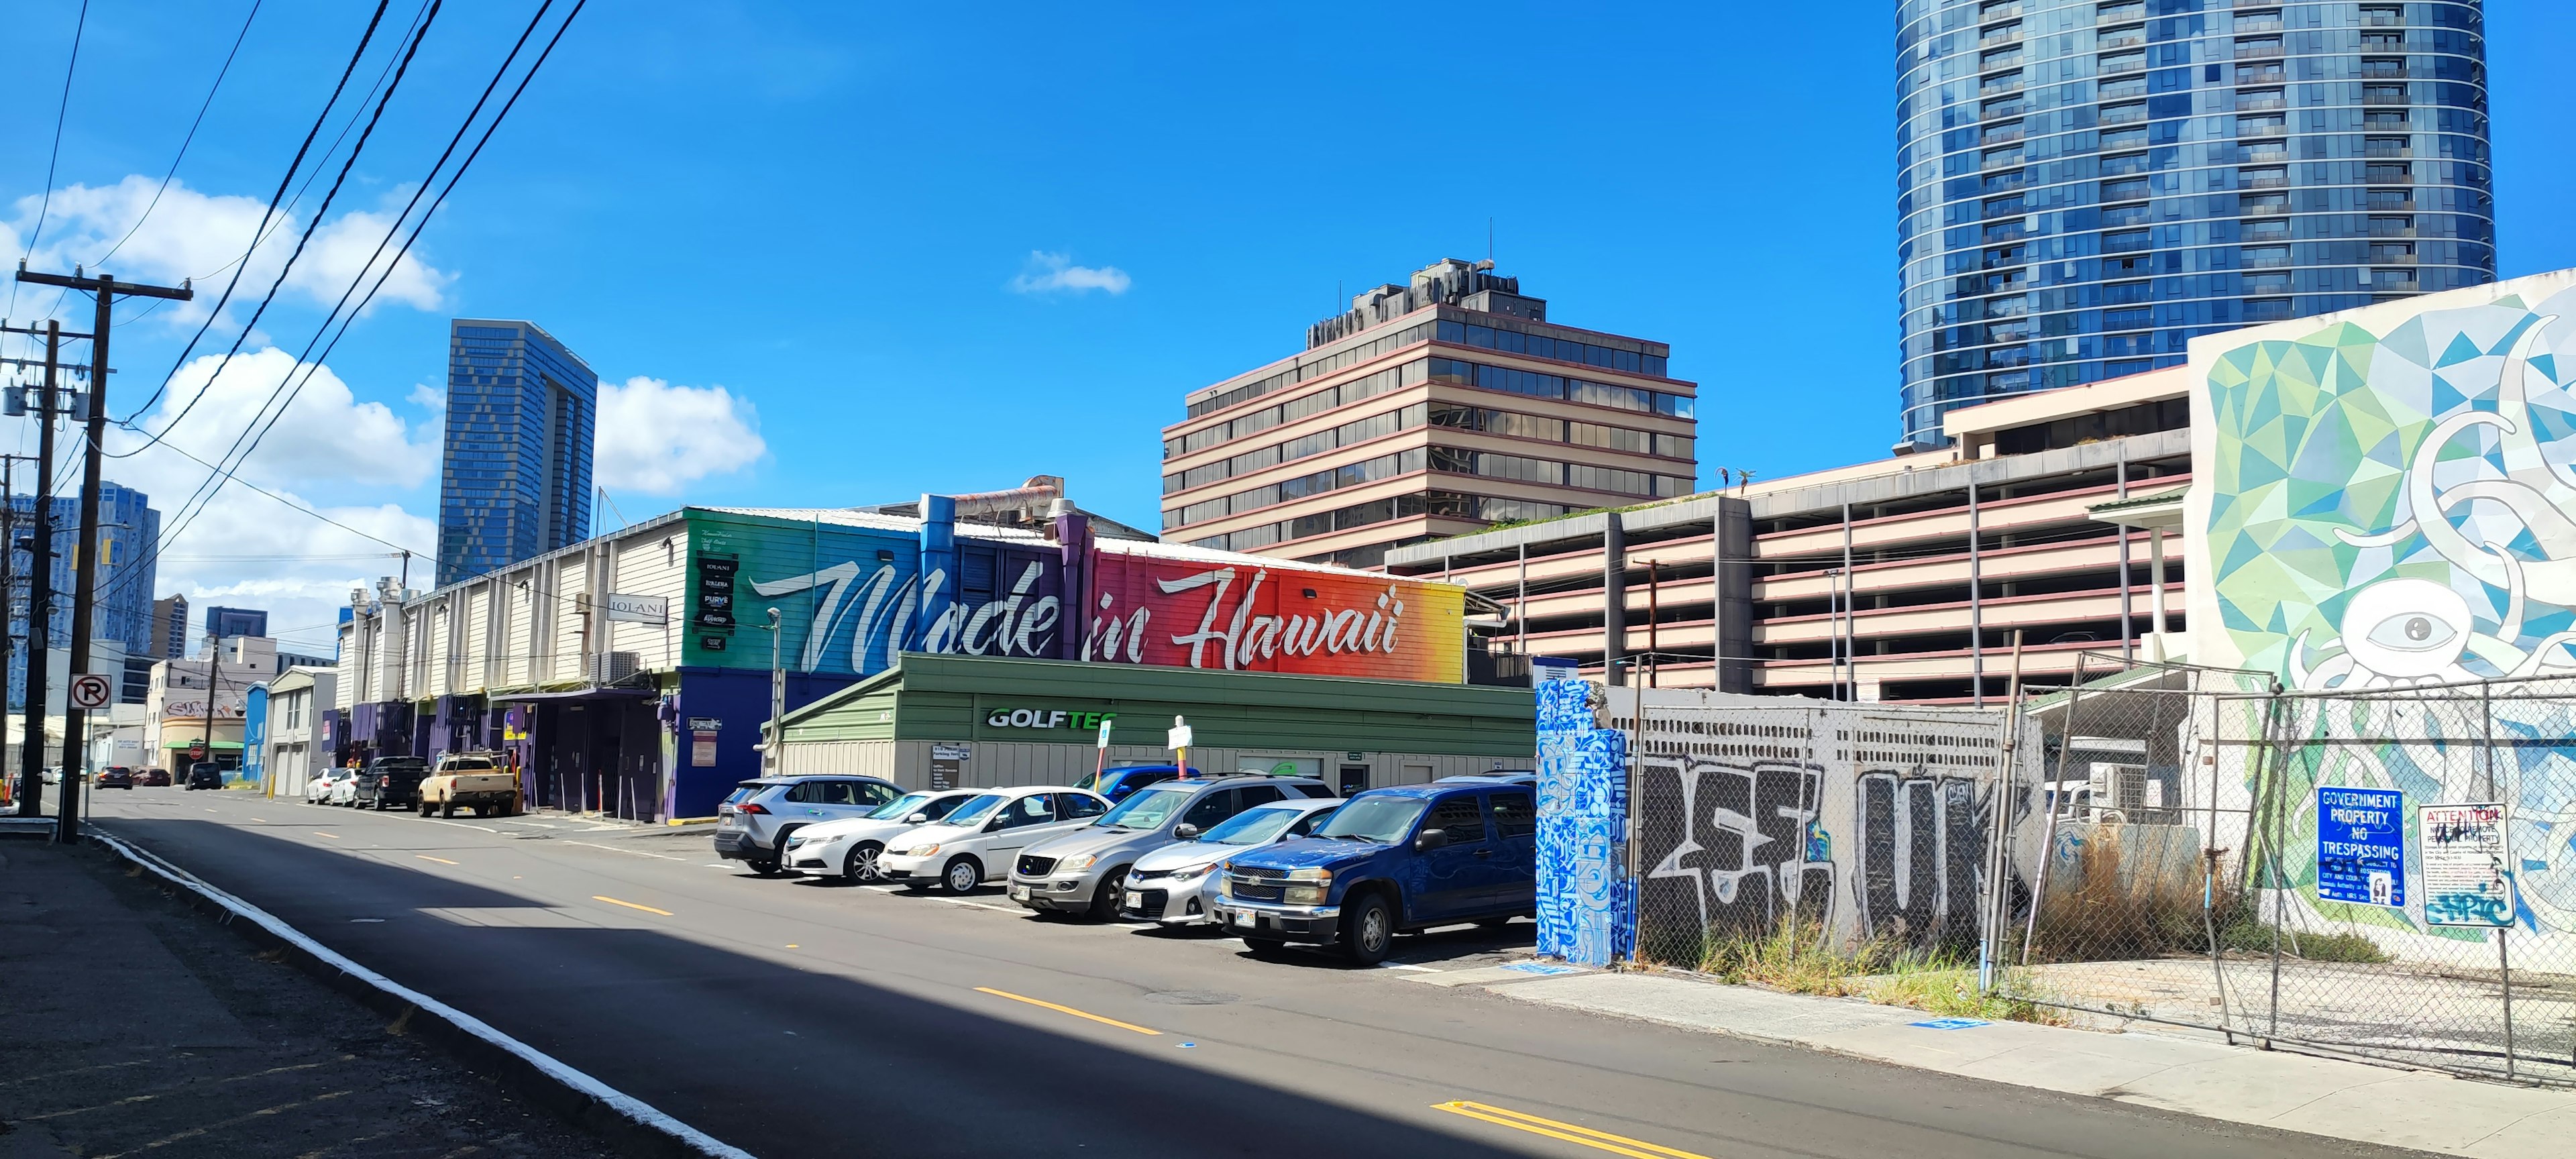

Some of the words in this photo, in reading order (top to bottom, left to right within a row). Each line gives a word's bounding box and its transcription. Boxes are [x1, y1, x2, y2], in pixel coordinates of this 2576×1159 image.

[612, 602, 662, 614] IOLANI
[748, 561, 1060, 673] Made
[1081, 591, 1151, 662] in
[1156, 566, 1405, 671] Hawaii
[2322, 791, 2398, 809] GOVERNMENT
[2330, 808, 2388, 826] PROPERTY
[2426, 809, 2498, 822] ATTENTION
[2352, 827, 2367, 841] NO
[2322, 841, 2400, 861] TRESPASSING
